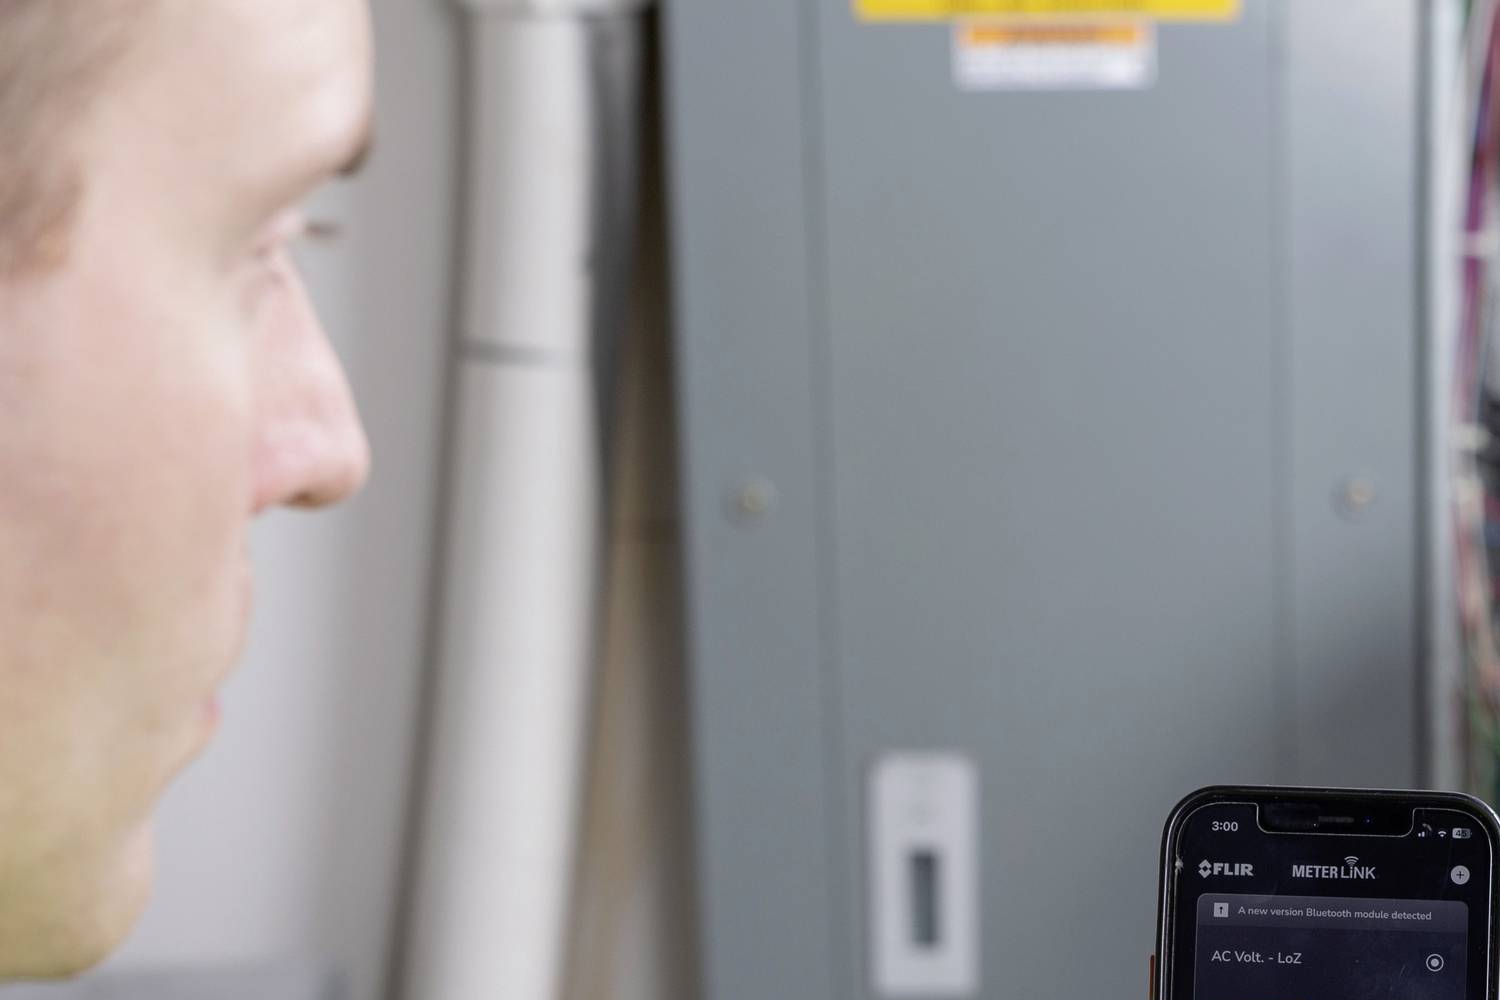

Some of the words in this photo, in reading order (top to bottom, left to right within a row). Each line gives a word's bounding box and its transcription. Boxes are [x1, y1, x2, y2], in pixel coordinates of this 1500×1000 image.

[1211, 821, 1239, 832] 3:00
[1213, 863, 1253, 876] FLIR
[1238, 906, 1246, 914] A
[1270, 908, 1304, 917] version
[1306, 908, 1352, 918] Bluetooth
[1354, 910, 1389, 919] module
[1391, 911, 1432, 920] detected
[1211, 950, 1231, 961] AC
[1234, 950, 1264, 963] Volt.
[1278, 952, 1302, 964] LoZ
